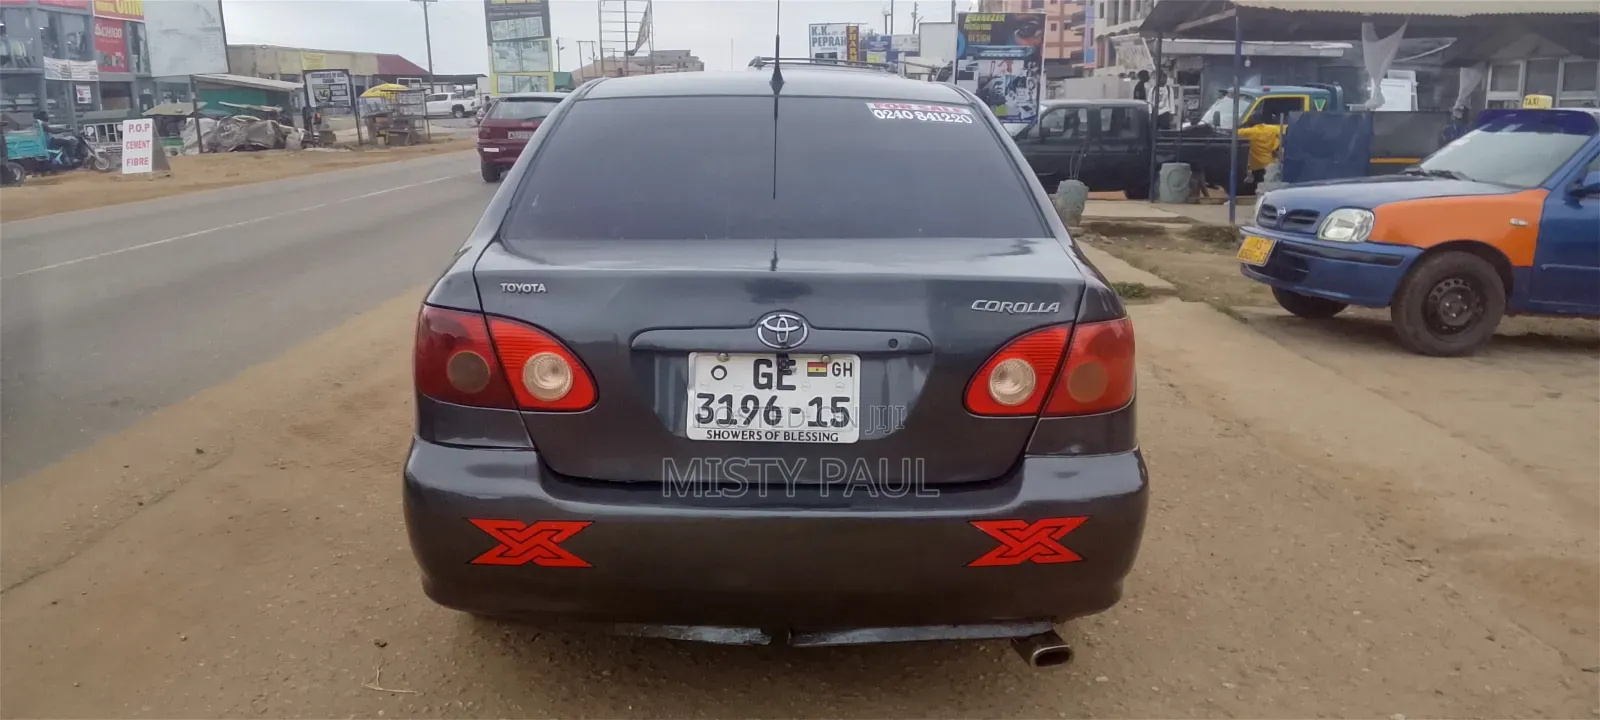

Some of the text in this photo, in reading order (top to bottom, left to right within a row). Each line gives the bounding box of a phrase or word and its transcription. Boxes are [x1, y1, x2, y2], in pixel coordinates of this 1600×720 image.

[101, 27, 123, 38] CHIGO
[811, 26, 831, 36] K.K.
[873, 109, 973, 124] 0240 841220
[128, 123, 150, 133] P.O.P
[125, 140, 150, 150] CEMENT
[126, 157, 149, 167] FIBRE
[500, 283, 546, 293] TOYOTA
[971, 299, 1060, 314] COROLLA
[753, 358, 797, 391] GE
[831, 362, 853, 377] GH
[706, 429, 839, 443] SHOWERS OF BLESSING
